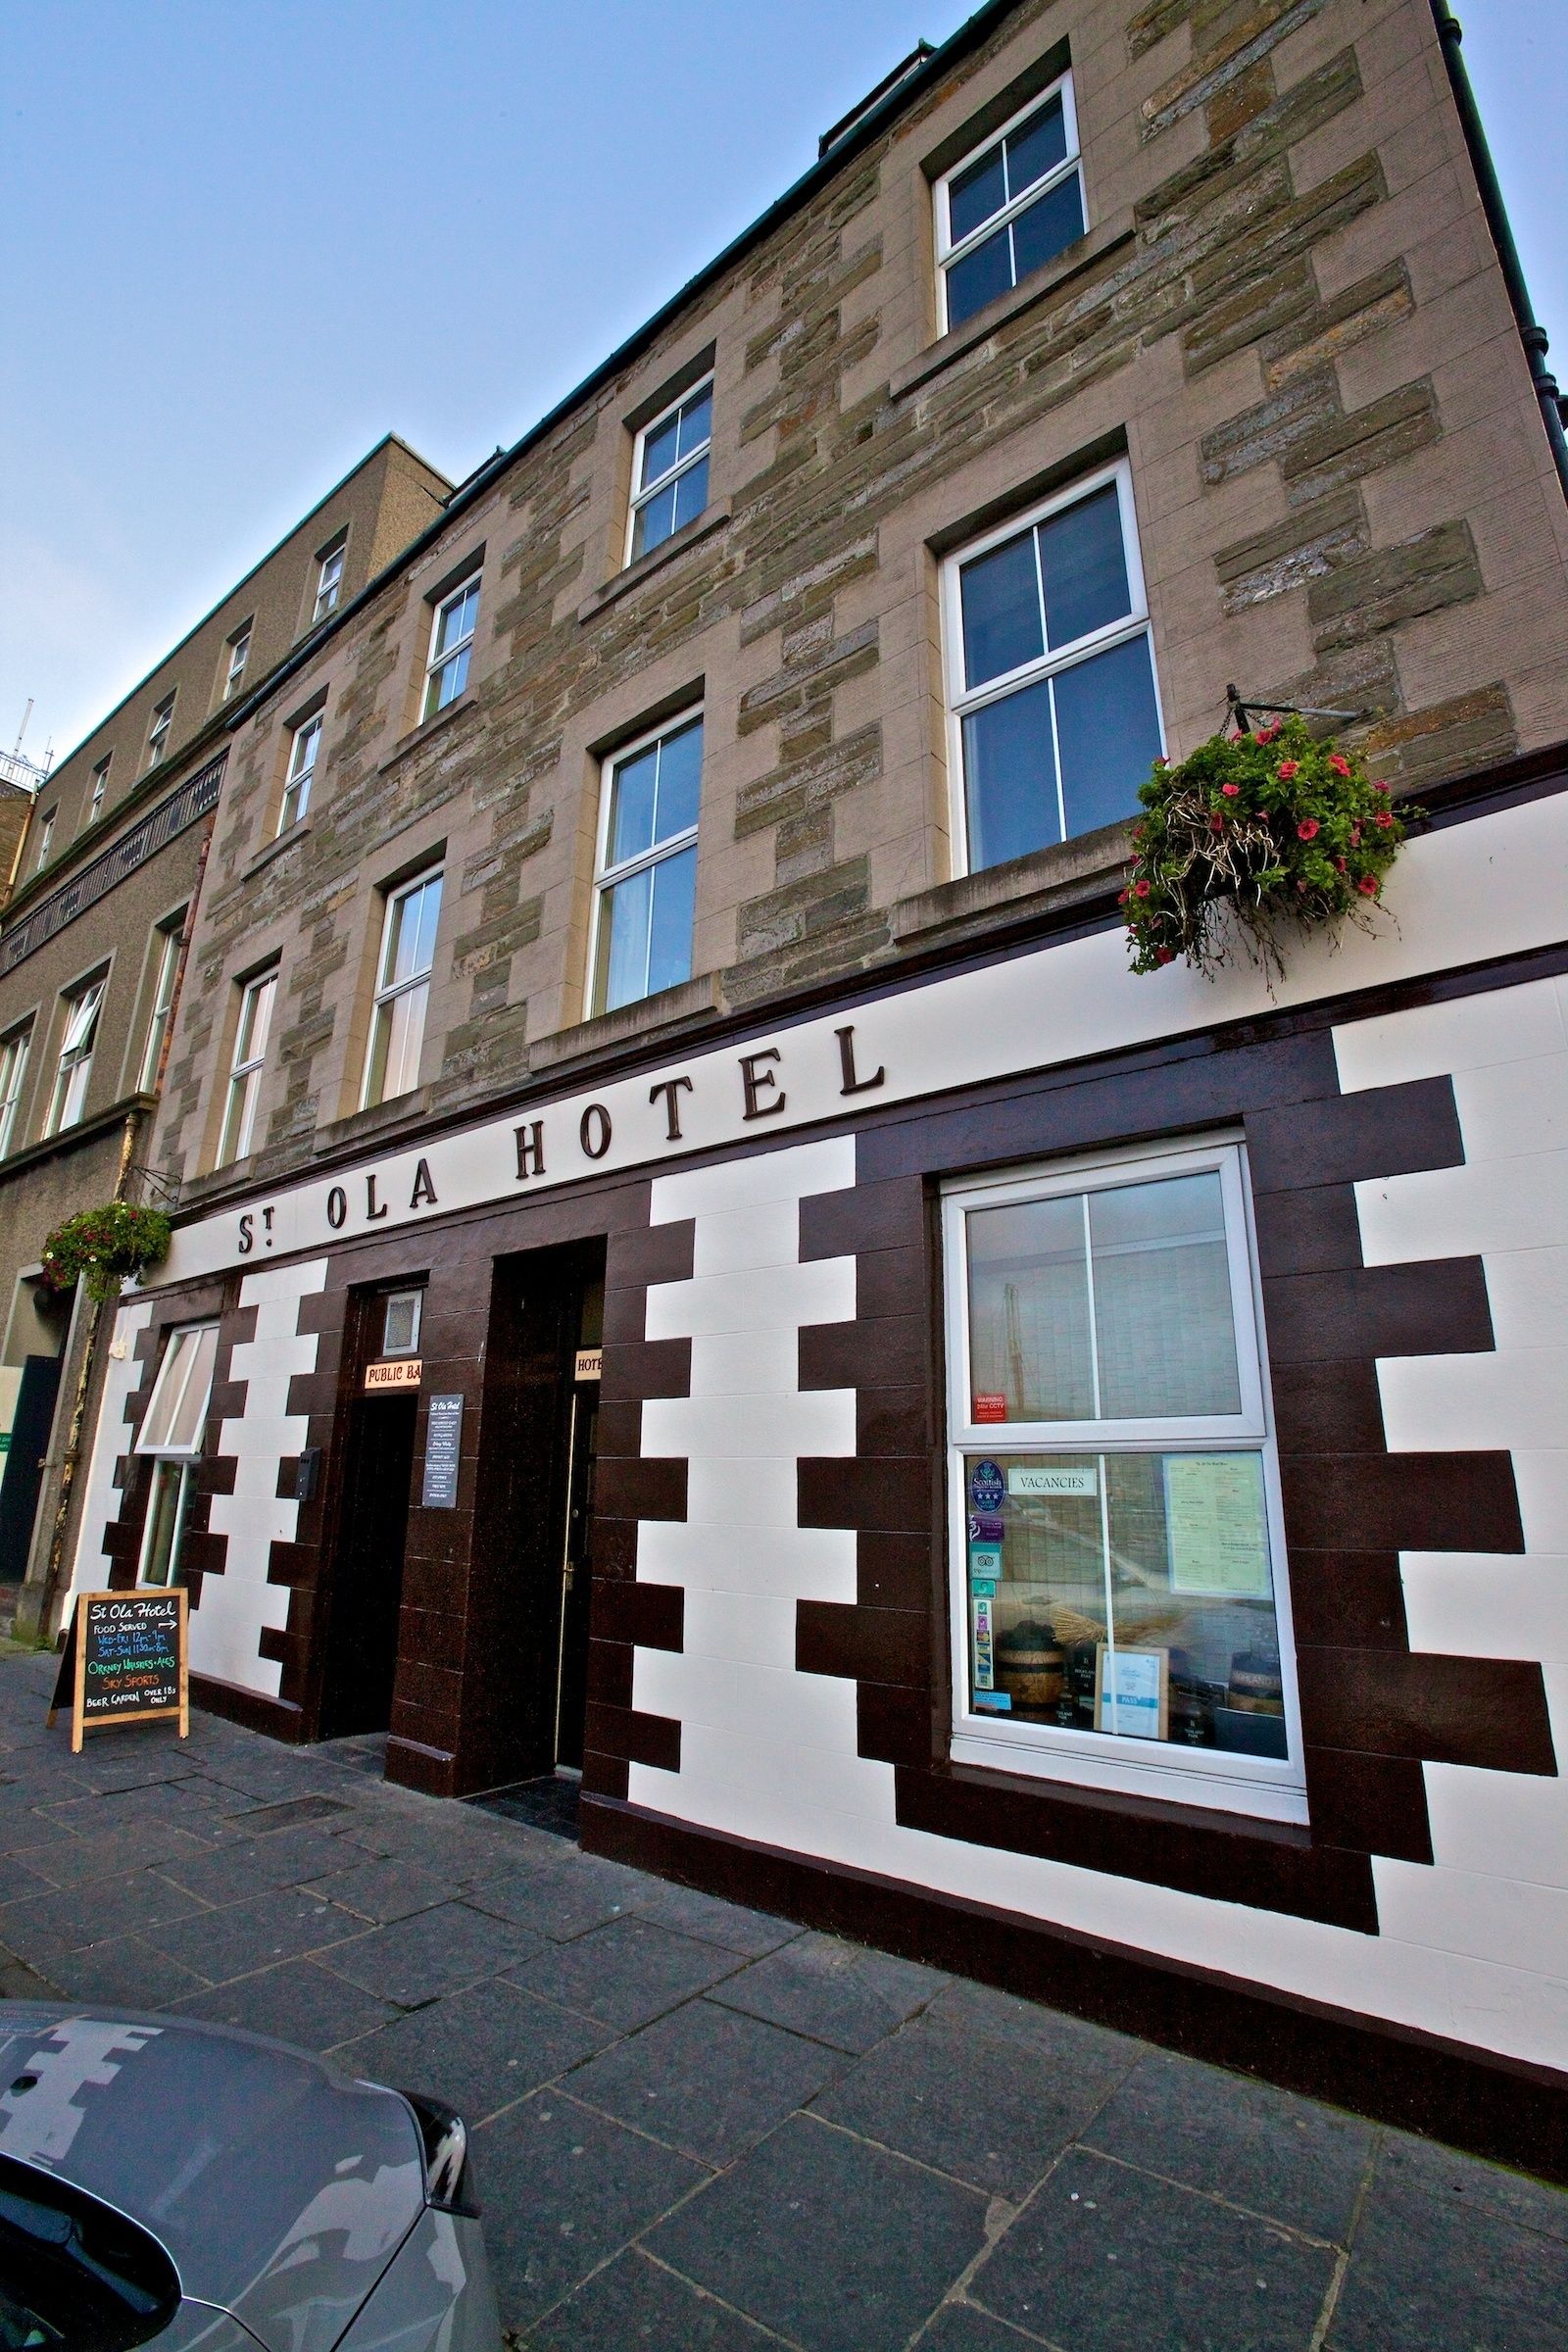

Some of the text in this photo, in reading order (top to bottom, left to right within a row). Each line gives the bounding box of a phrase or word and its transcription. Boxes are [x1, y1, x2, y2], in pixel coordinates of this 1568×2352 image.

[326, 1158, 439, 1230] OLA
[513, 1024, 886, 1181] HOTEL
[577, 1356, 603, 1371] HOTE
[368, 1364, 421, 1383] PUBLIC BA
[973, 1478, 1003, 1487] Scottish
[1020, 1477, 1084, 1489] VACANCIES
[90, 1600, 176, 1620] St Ola Hotel
[93, 1622, 147, 1635] FOOD SERVED
[87, 1661, 122, 1675] ORKNEY
[102, 1673, 160, 1690] SKY SPORTS
[86, 1691, 140, 1707] BEER GARDEN
[150, 1694, 168, 1704] ONLY
